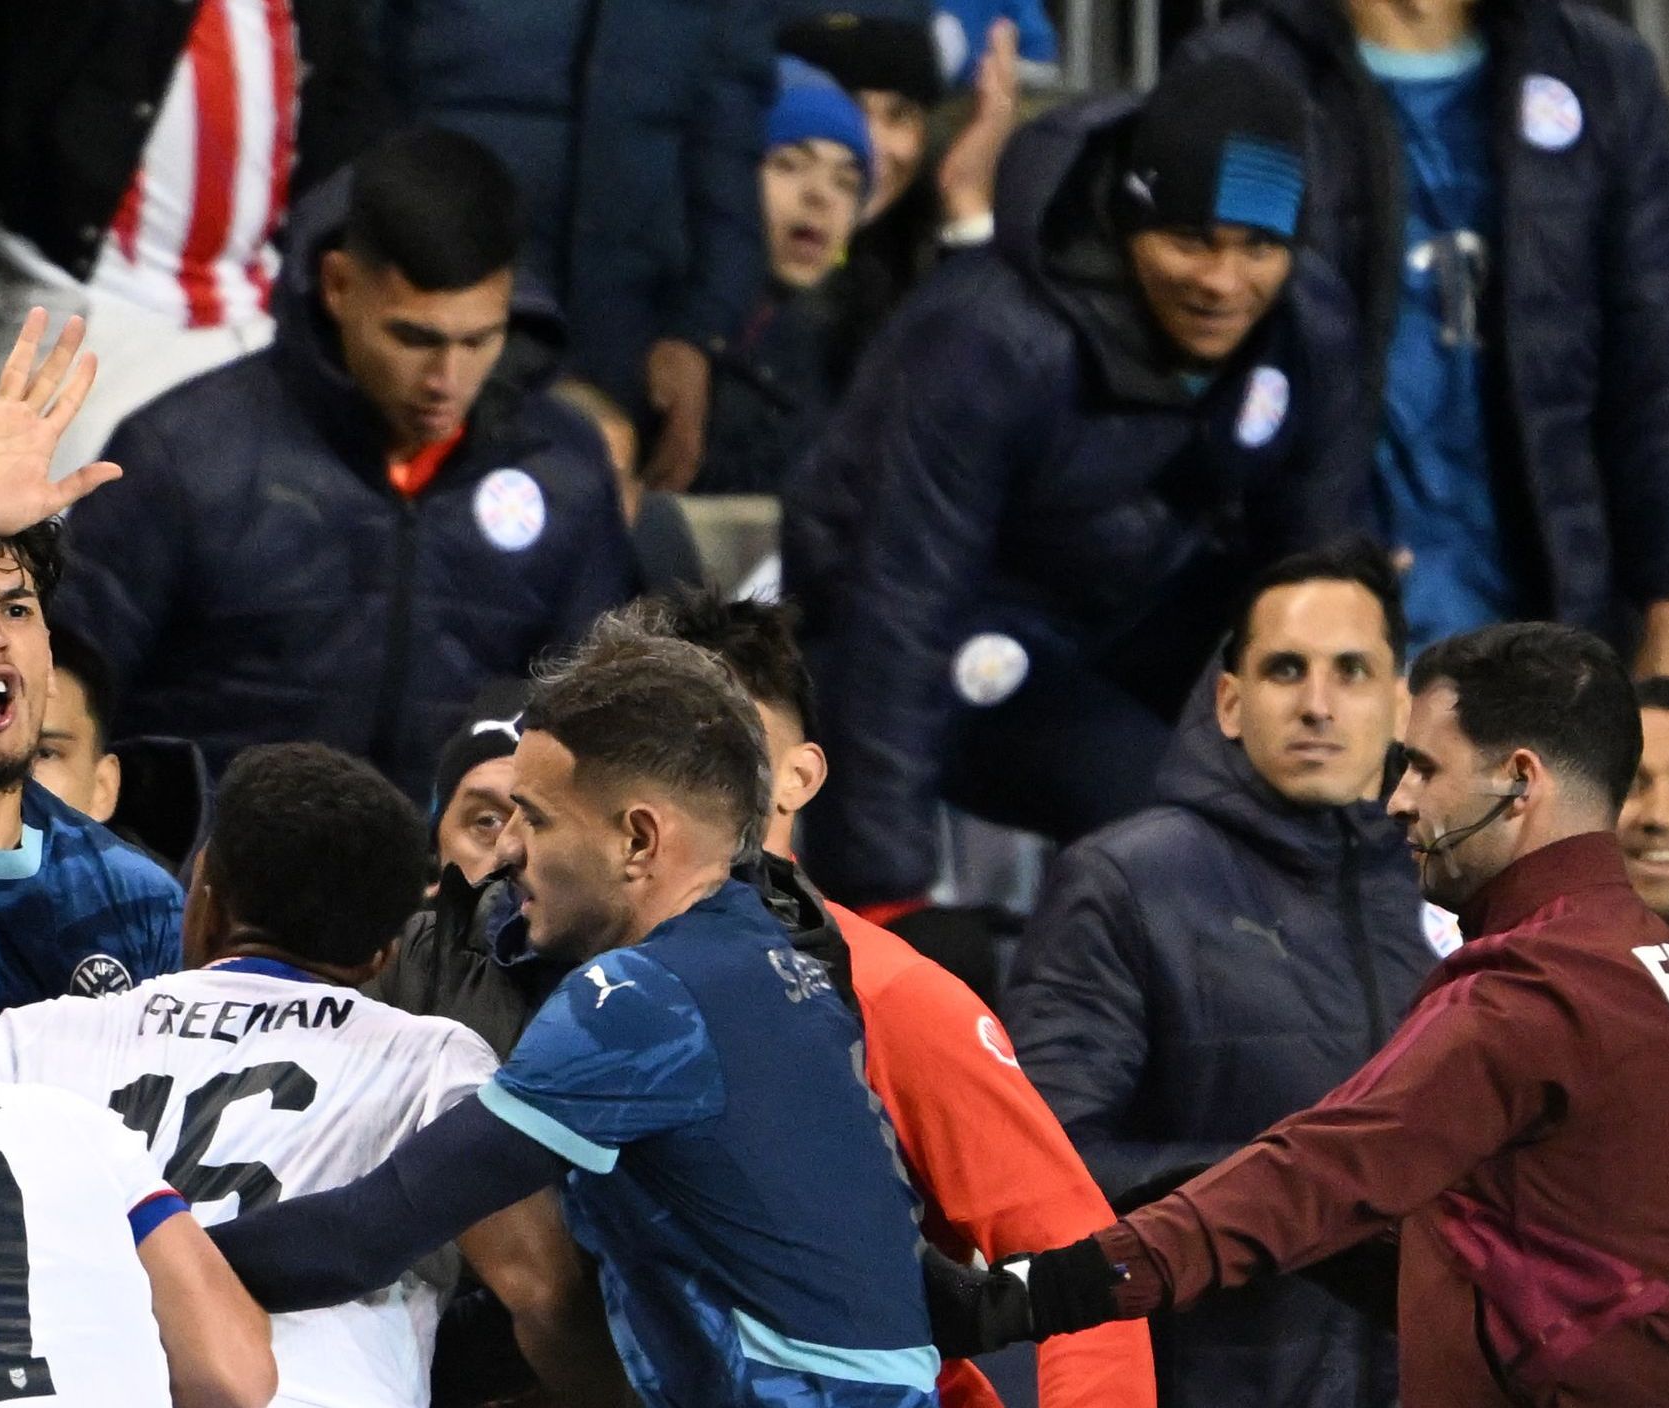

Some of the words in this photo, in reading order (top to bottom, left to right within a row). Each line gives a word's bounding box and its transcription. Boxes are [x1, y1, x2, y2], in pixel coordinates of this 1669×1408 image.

[93, 961, 115, 977] APF
[138, 994, 354, 1044] FREEMAN
[108, 1060, 318, 1229] 16
